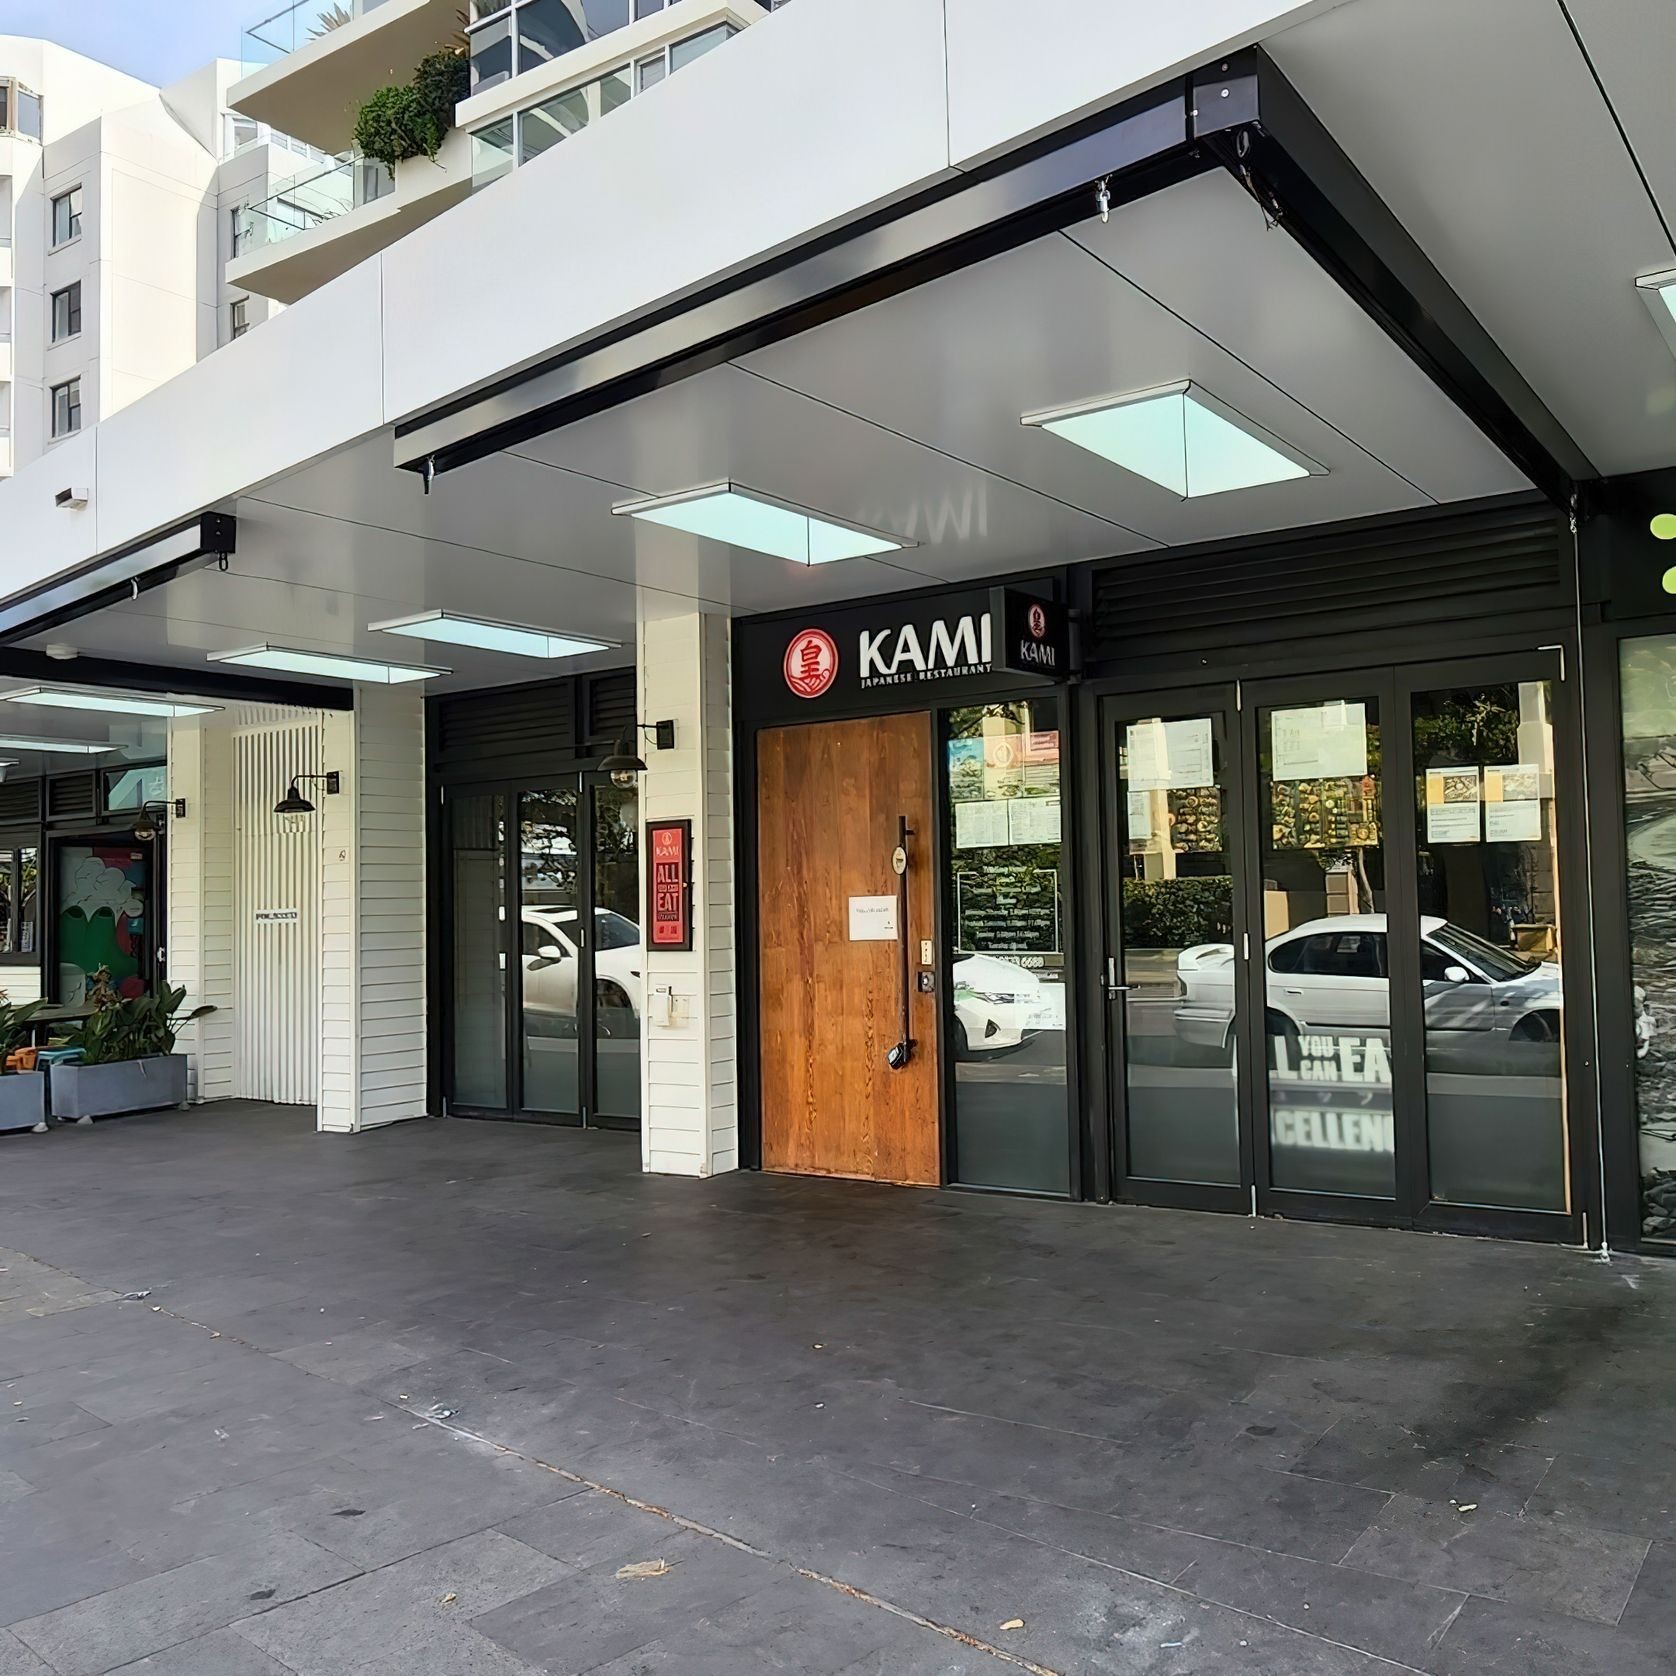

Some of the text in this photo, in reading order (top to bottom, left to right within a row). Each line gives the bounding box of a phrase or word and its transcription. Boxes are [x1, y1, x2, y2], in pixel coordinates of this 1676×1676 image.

[859, 612, 992, 678] KAMI
[1020, 639, 1055, 666] KAMI
[861, 663, 992, 689] JAPANESE RESTAURANT
[657, 864, 679, 882] ALL
[657, 893, 679, 911] EAT
[1269, 1036, 1298, 1080] L
[1298, 1035, 1334, 1057] YOU
[1300, 1059, 1337, 1081] CAN
[1271, 1110, 1394, 1152] CELLEN
